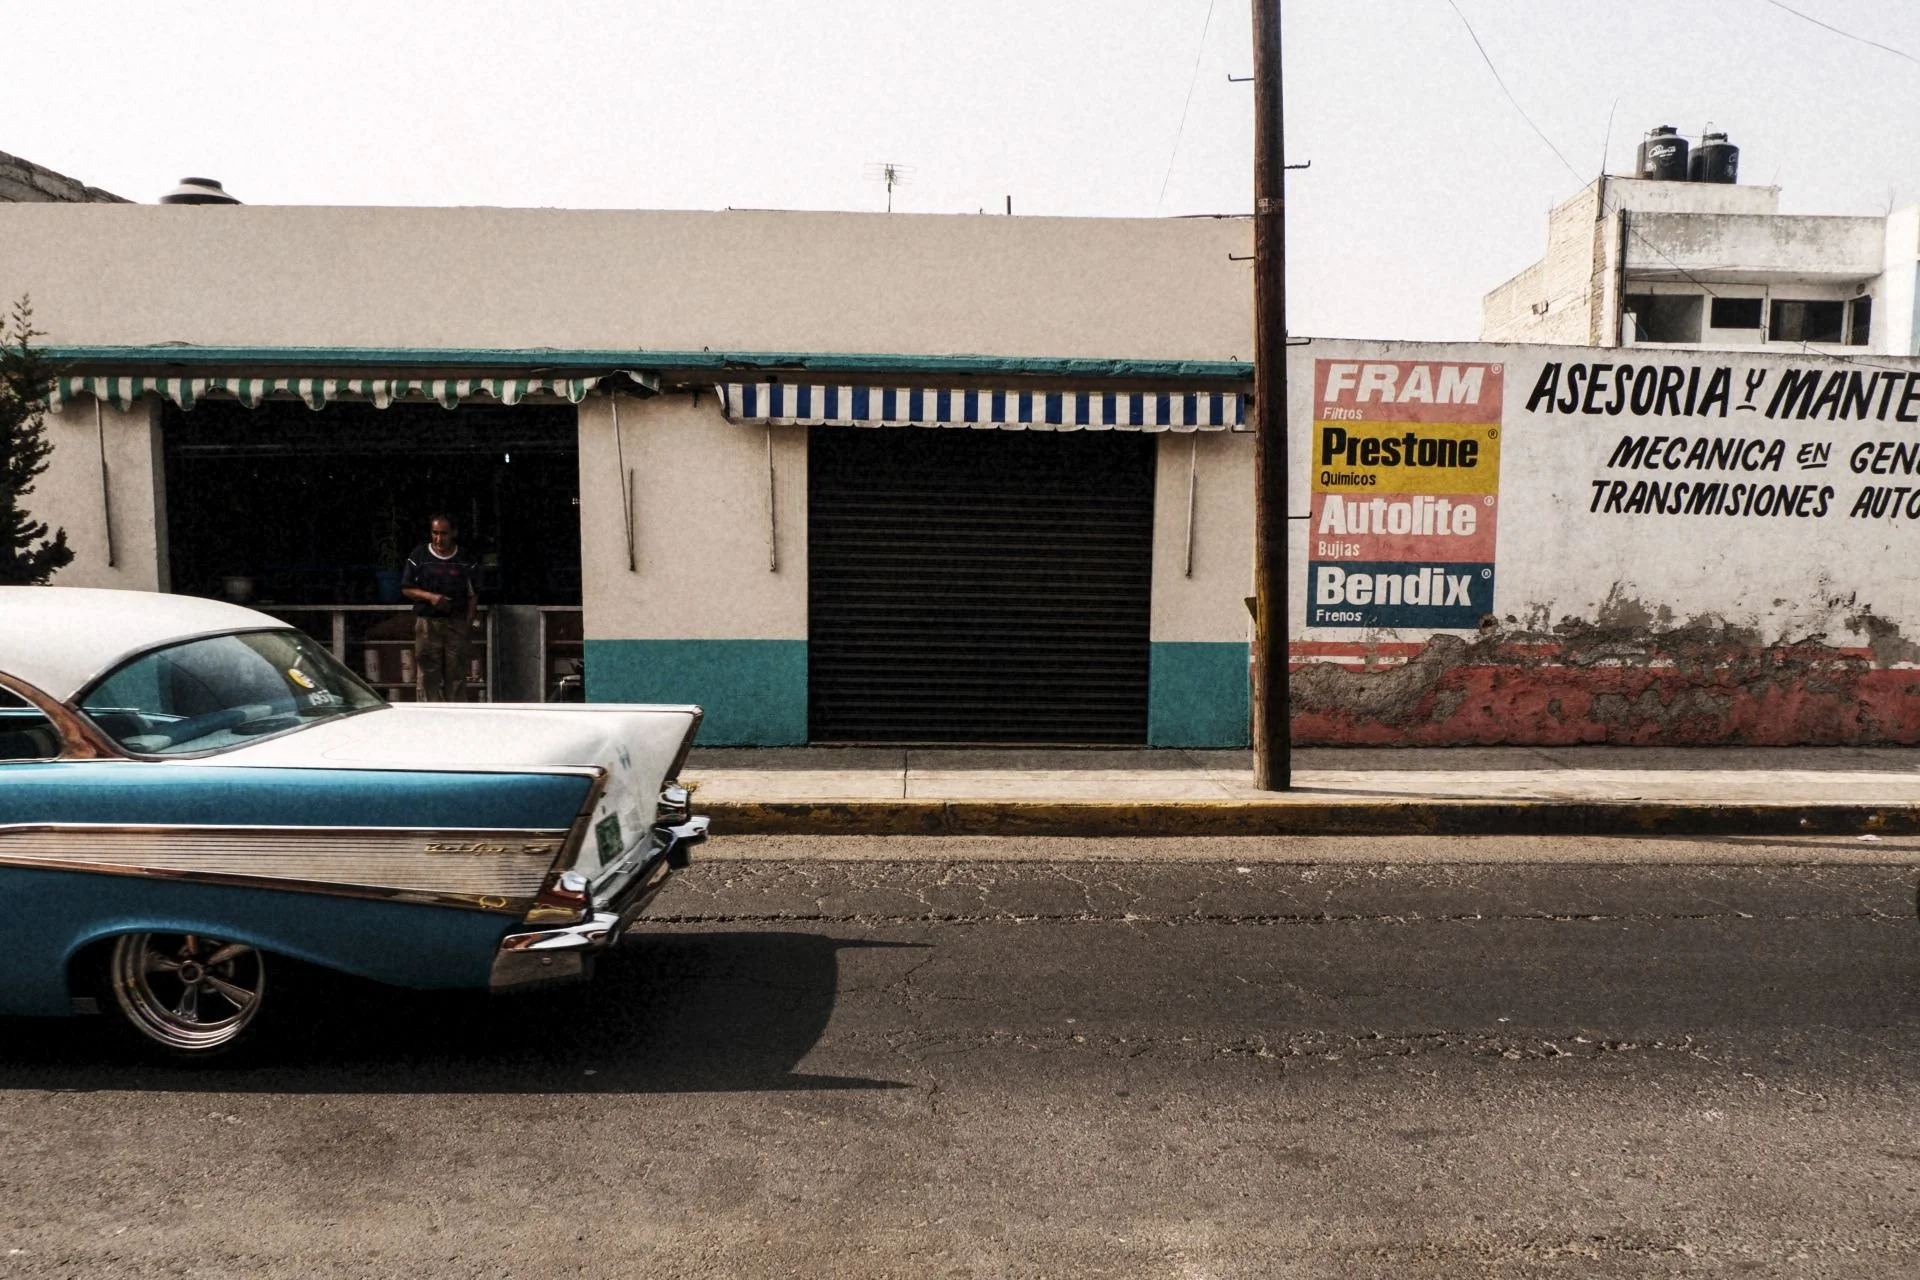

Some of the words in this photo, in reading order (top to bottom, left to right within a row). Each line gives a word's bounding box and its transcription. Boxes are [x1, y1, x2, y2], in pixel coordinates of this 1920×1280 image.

[1323, 363, 1485, 404] FRAM
[1525, 362, 1731, 418] ASESORIA
[1742, 367, 1767, 406] Y
[1323, 407, 1363, 420] Filtros
[1321, 427, 1479, 468] Prestone
[1607, 435, 1786, 472] MECANICA
[1796, 442, 1832, 467] EN
[1850, 441, 1920, 475] GEN
[1320, 471, 1377, 486] Quimicos
[1318, 495, 1477, 536] Autolite
[1590, 480, 1835, 518] TRANSMISIONES
[1318, 541, 1360, 560] Bujias
[1316, 566, 1472, 607] Bendix
[1315, 609, 1363, 622] Frenos
